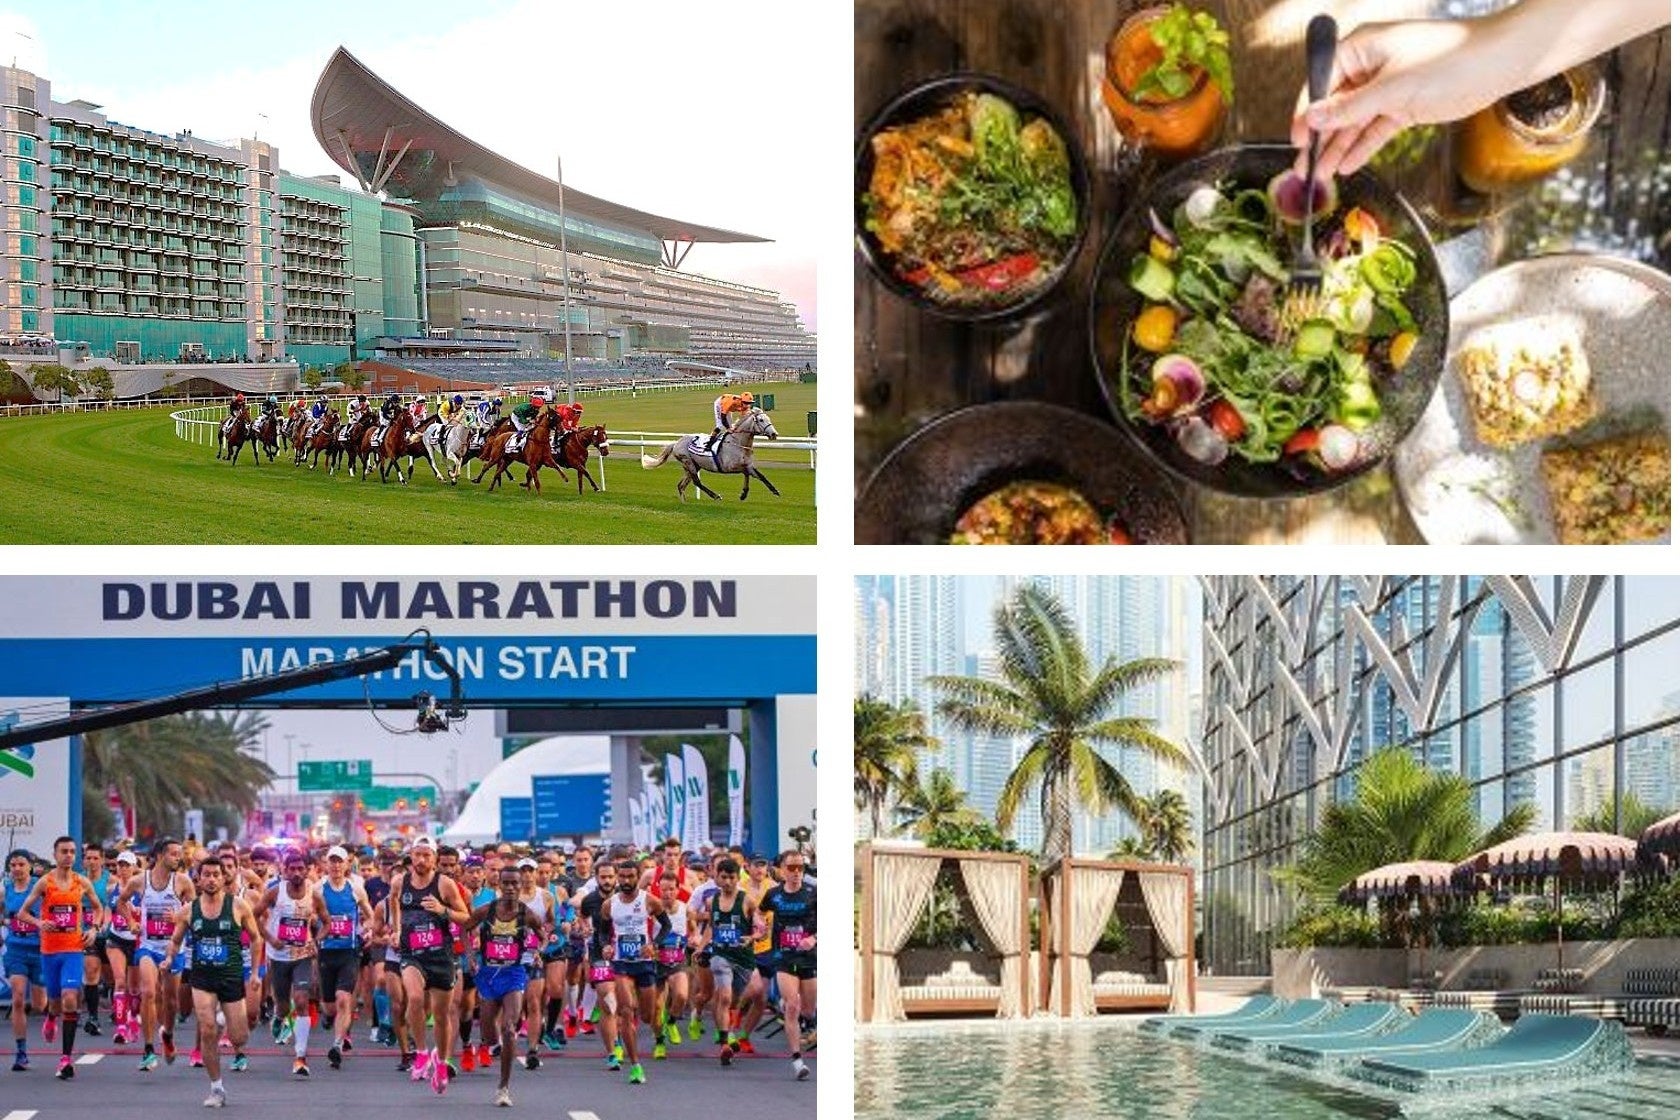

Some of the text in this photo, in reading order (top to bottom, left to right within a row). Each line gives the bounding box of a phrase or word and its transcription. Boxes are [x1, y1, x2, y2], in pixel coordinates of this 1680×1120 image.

[102, 580, 737, 621] DUBAI MARATHON
[498, 646, 637, 680] START
